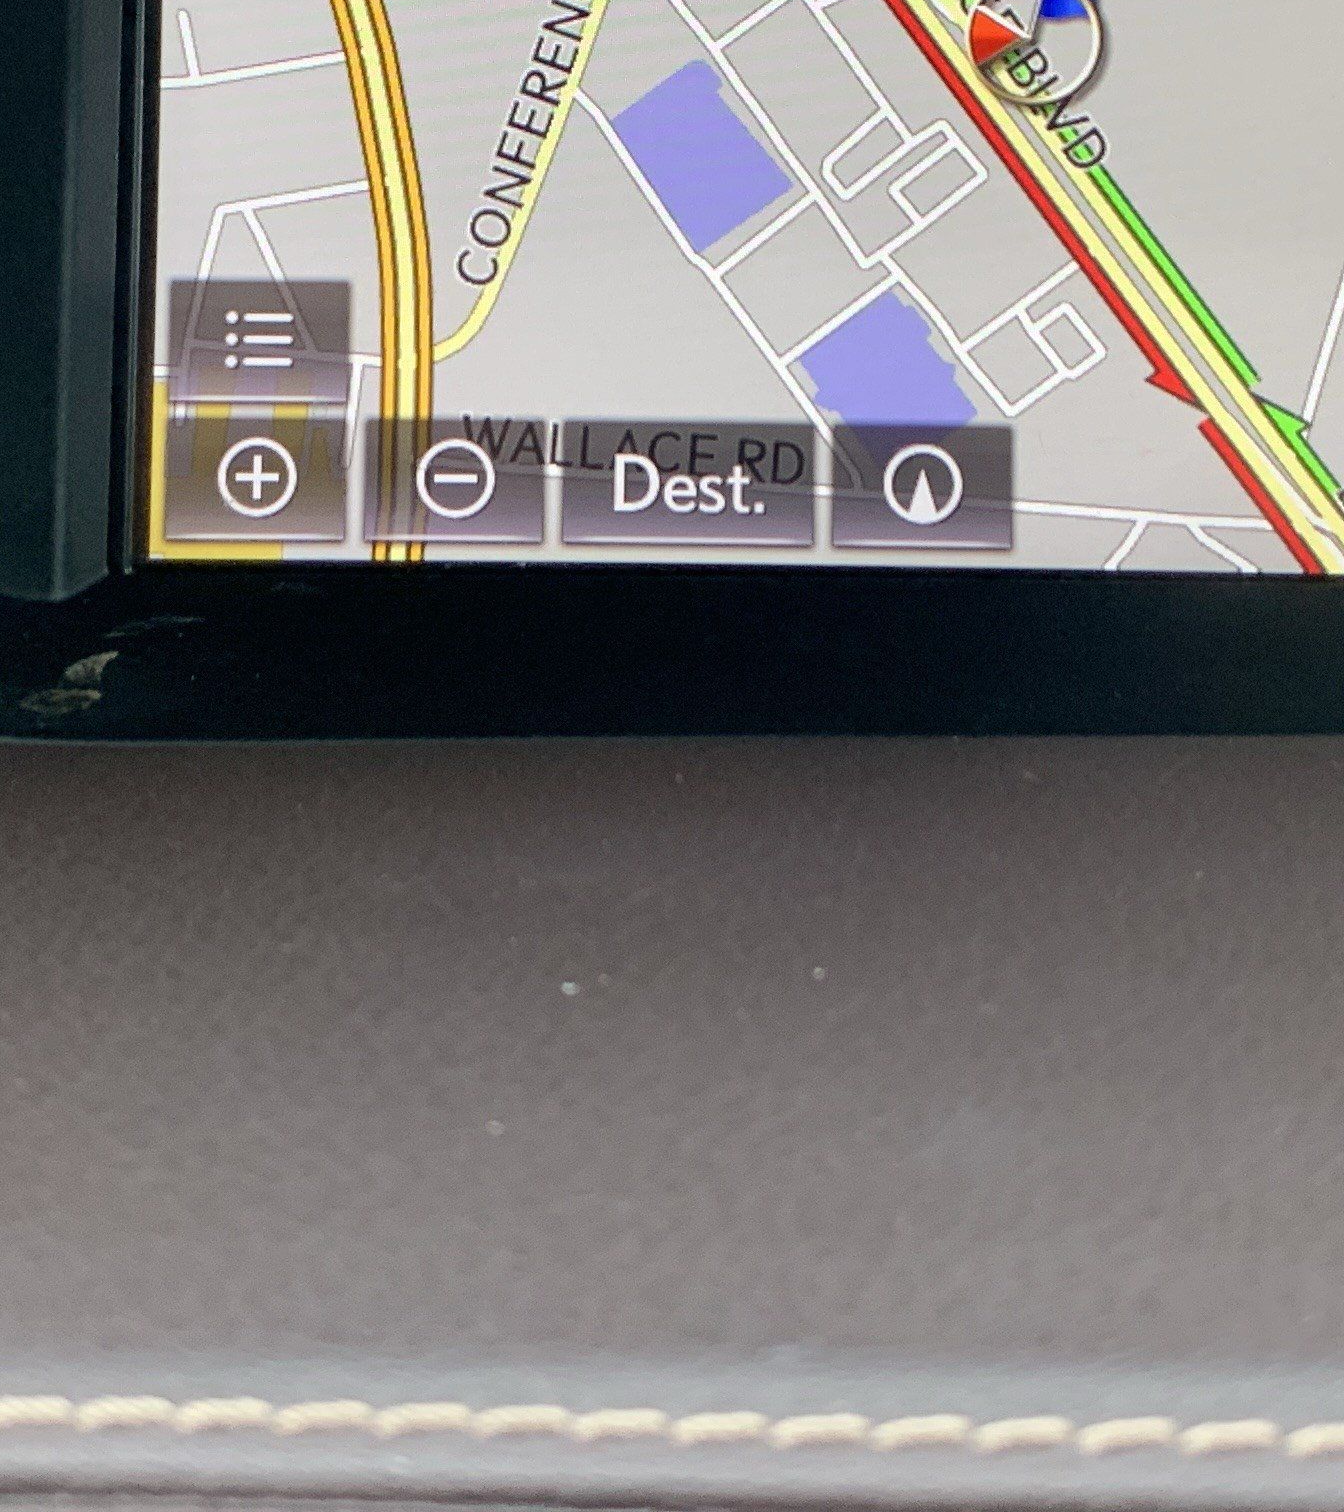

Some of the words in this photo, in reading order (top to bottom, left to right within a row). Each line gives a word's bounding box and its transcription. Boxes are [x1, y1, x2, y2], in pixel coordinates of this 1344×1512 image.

[461, 414, 720, 476] WALLACE
[736, 438, 805, 484] RD
[613, 453, 766, 515] Dest.
